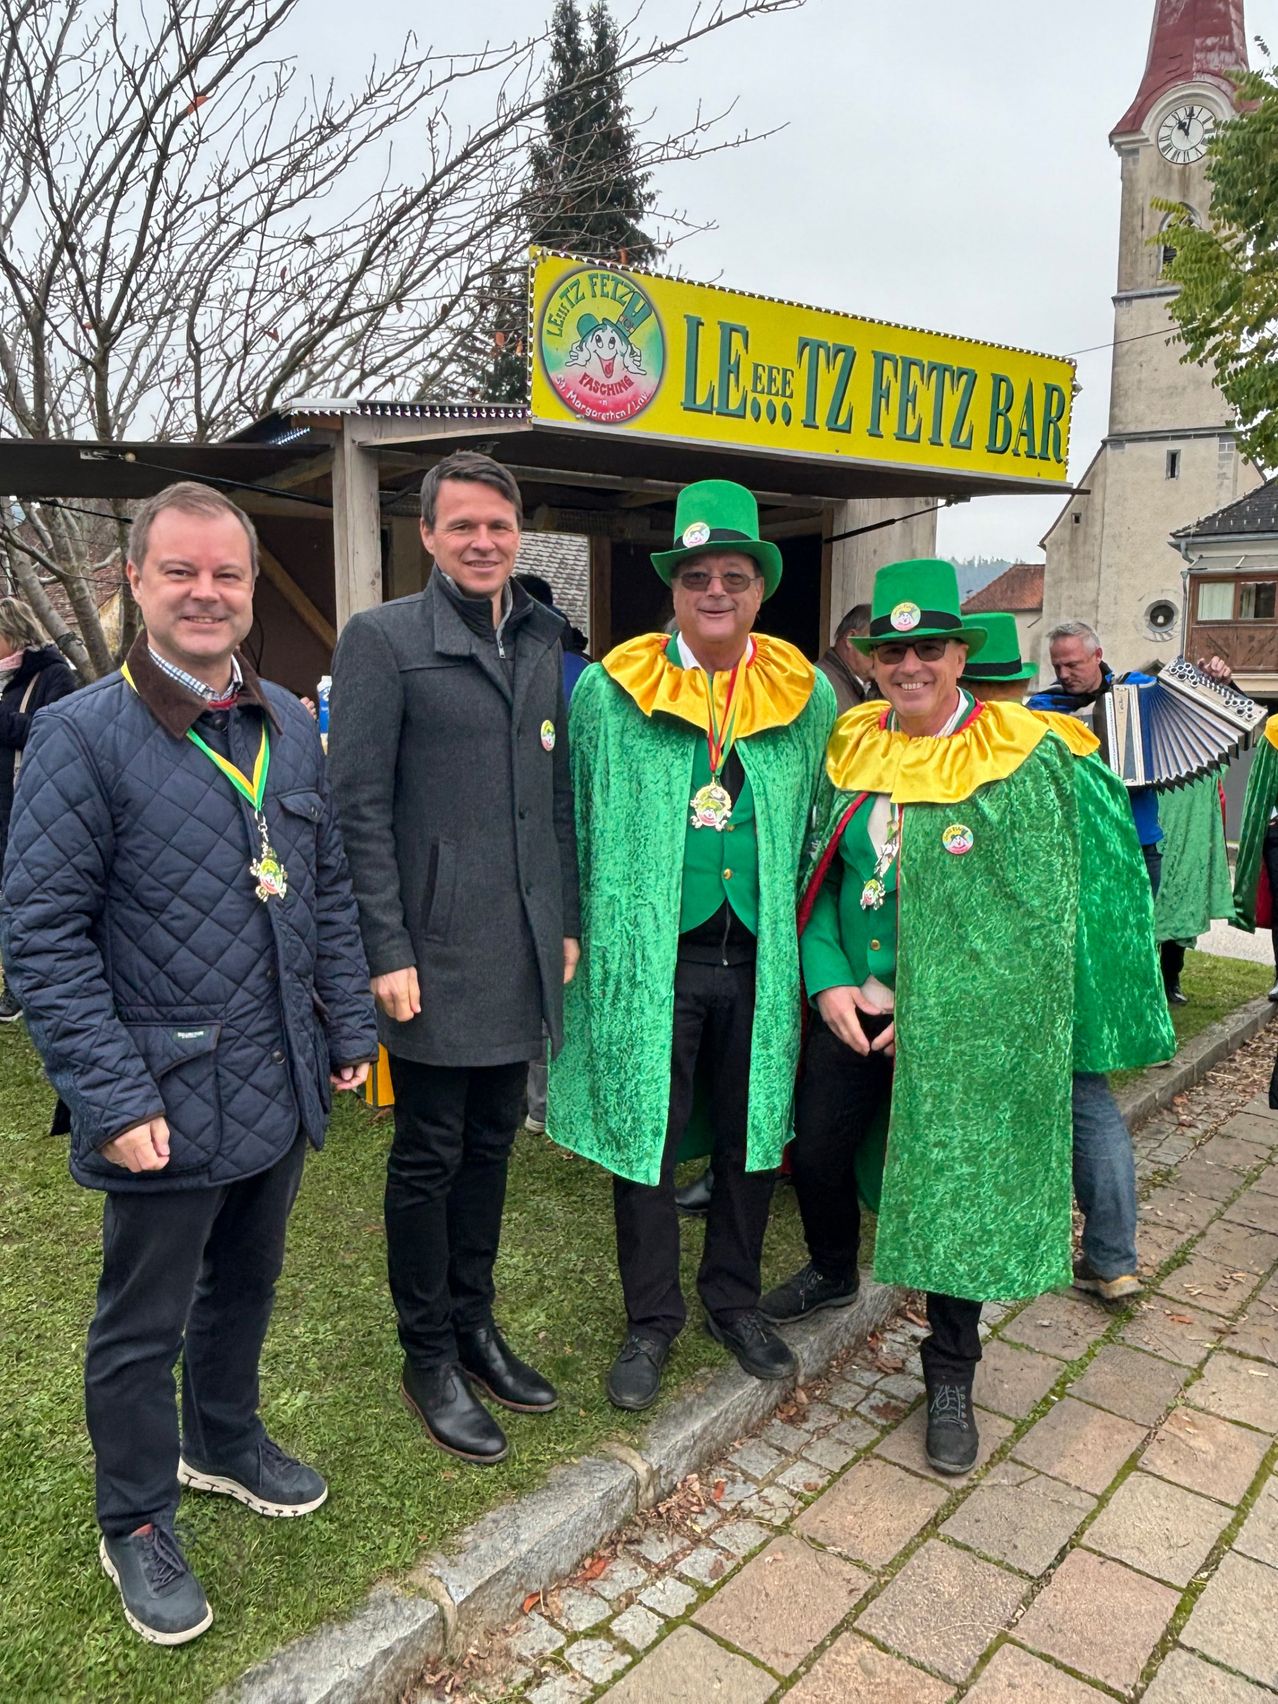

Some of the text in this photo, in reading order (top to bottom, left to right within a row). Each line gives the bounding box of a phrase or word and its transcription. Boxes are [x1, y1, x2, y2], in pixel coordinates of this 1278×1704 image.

[579, 372, 635, 397] FASCHING
[866, 350, 978, 450] FETZ
[986, 373, 1066, 464] BAR
